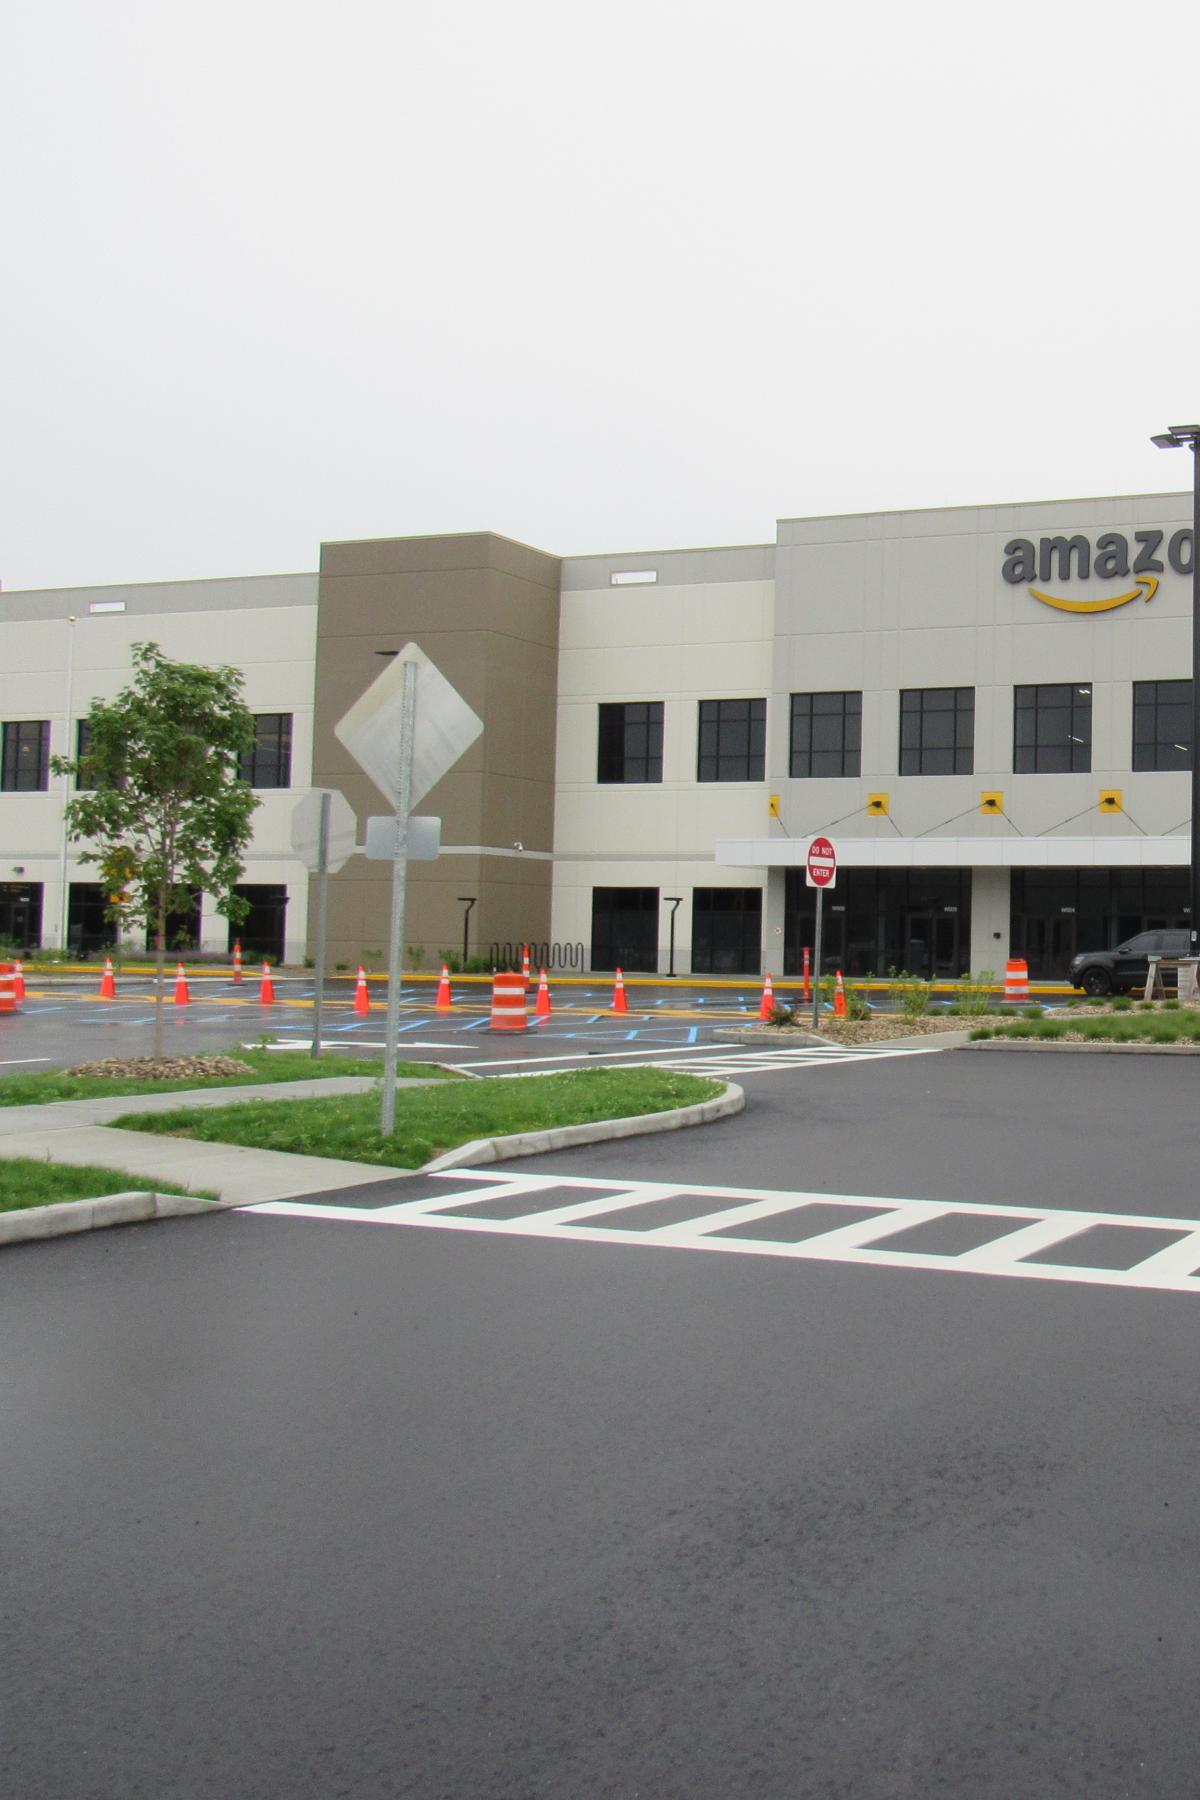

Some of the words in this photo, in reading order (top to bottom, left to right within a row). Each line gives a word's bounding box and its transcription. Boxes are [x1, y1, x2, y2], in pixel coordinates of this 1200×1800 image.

[811, 845, 820, 855] DO
[821, 847, 833, 856] NOT
[812, 868, 830, 878] ENTER
